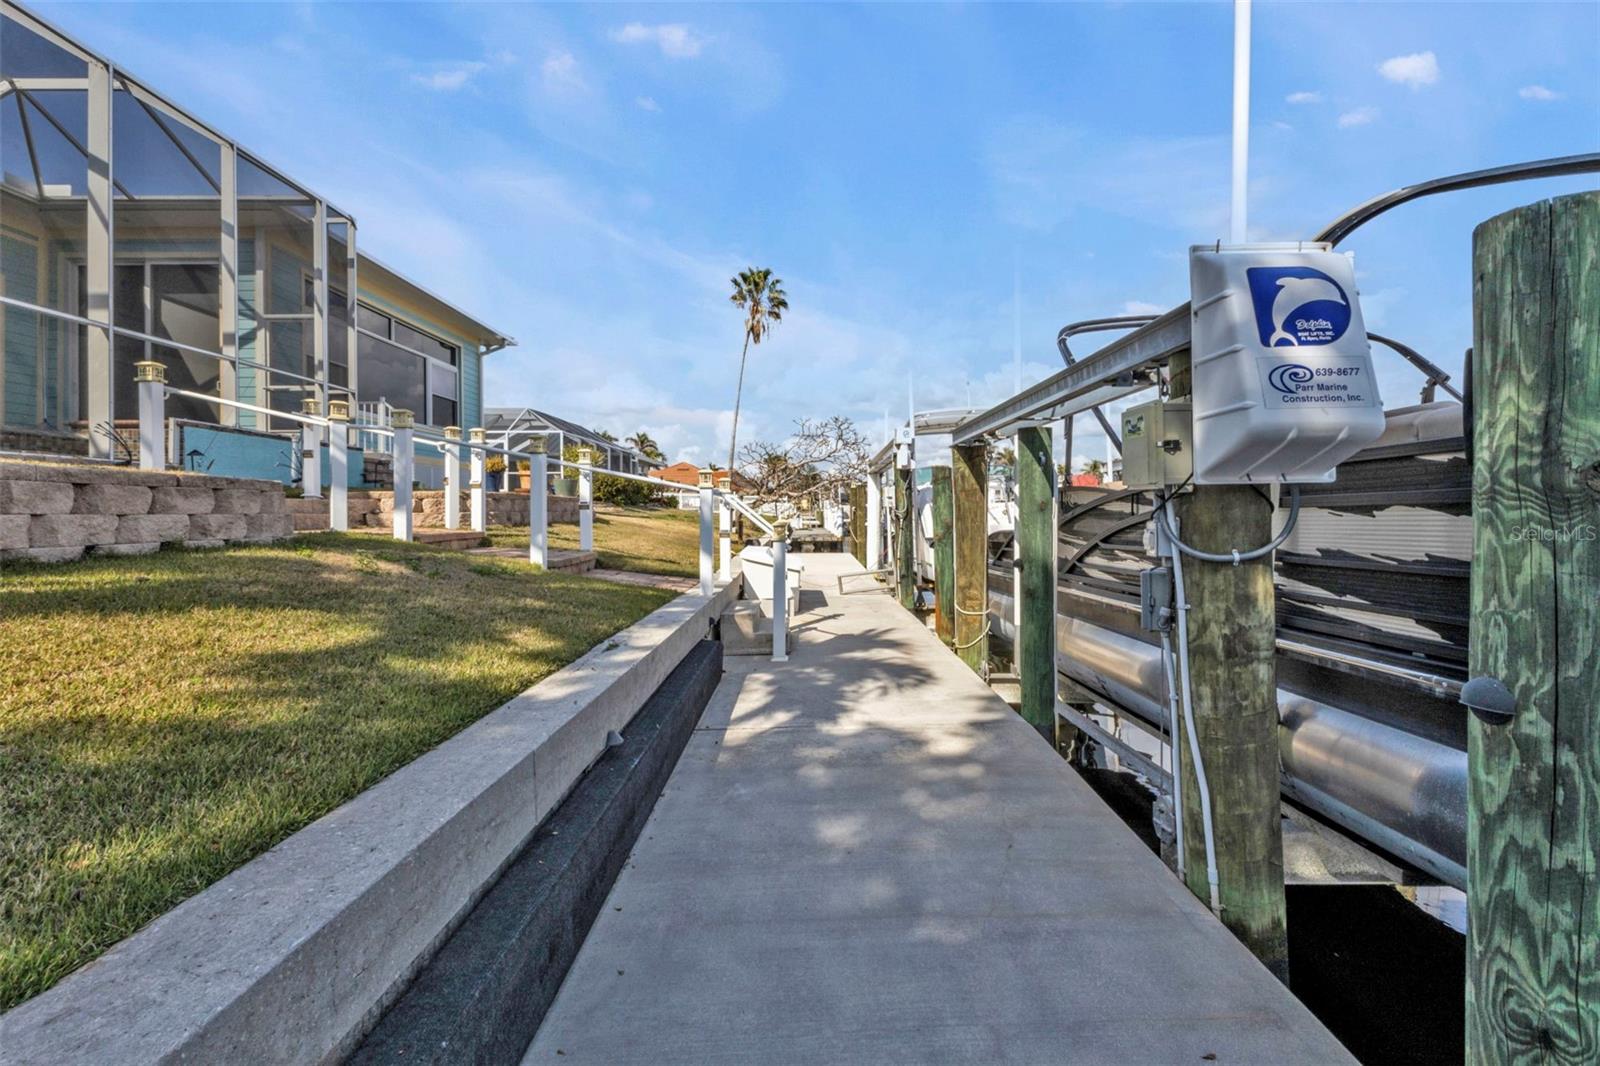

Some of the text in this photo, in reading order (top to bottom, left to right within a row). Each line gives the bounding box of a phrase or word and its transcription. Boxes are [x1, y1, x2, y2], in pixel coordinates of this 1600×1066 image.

[1315, 367, 1360, 376] 639-8677
[1295, 383, 1348, 392] Parr Marine
[1282, 393, 1365, 403] Construction, Inc.
